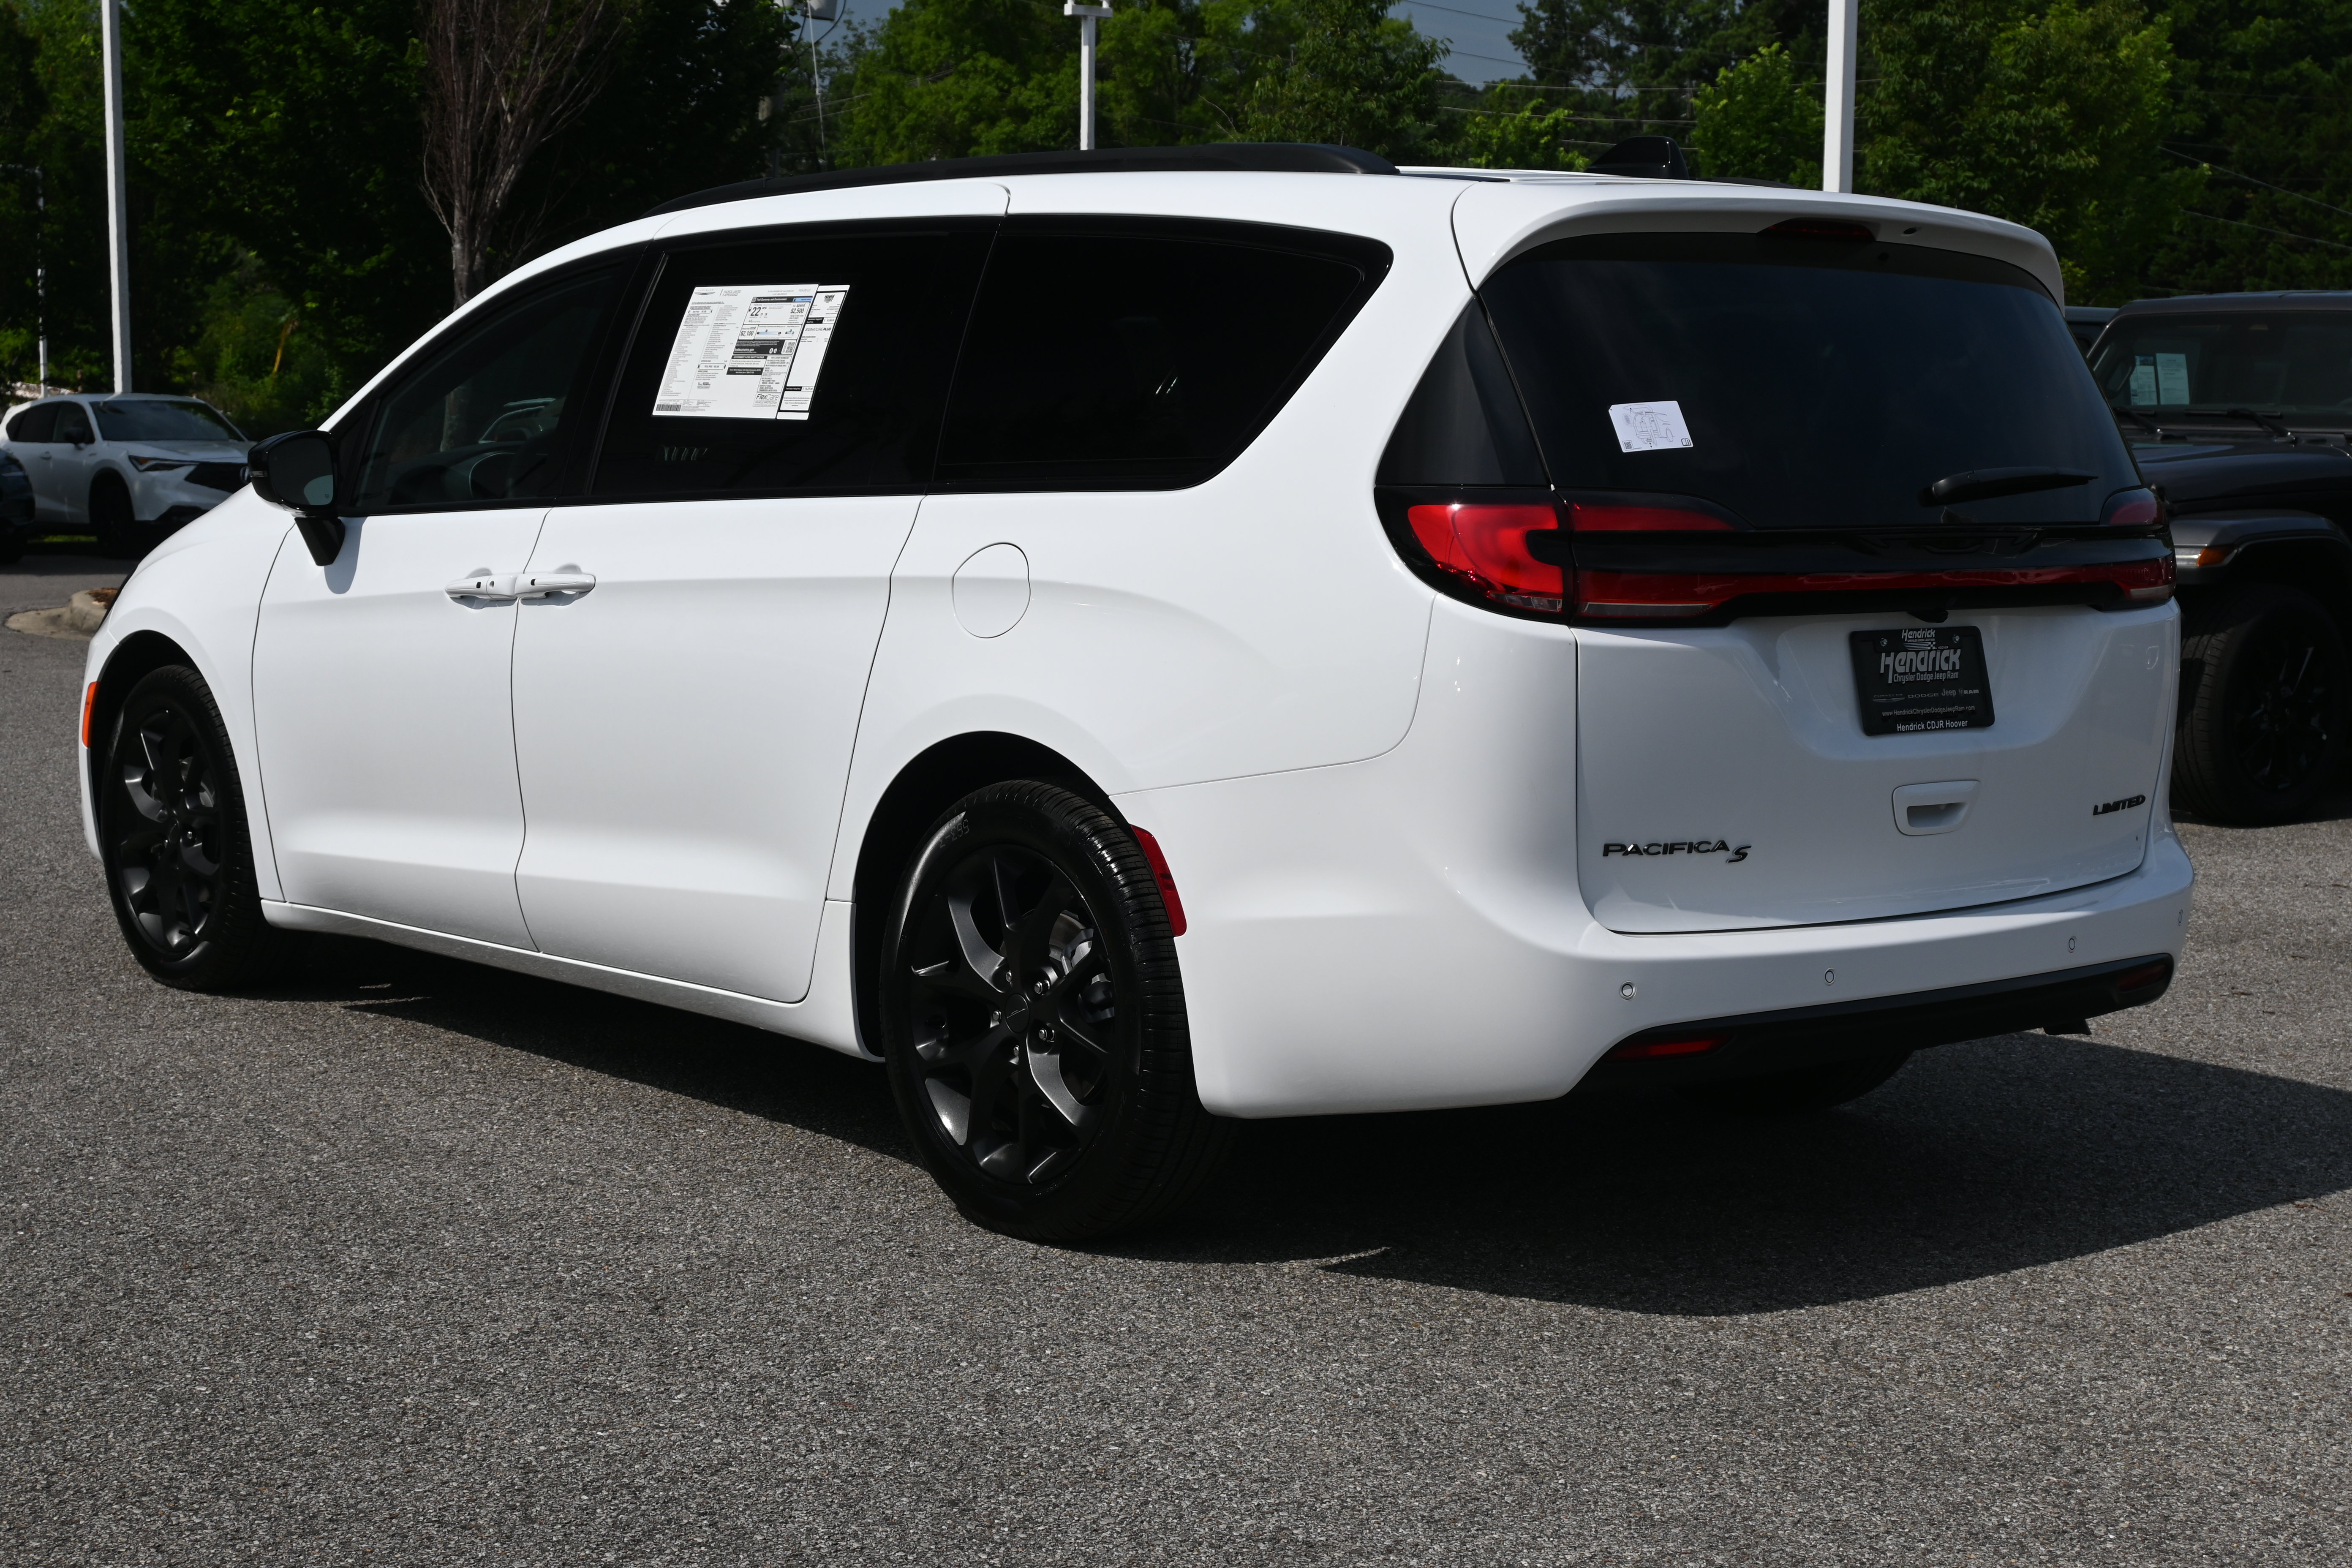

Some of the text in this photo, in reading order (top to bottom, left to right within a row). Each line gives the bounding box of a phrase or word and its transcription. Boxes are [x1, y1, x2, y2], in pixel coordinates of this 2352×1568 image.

[750, 307, 761, 316] 22
[1902, 629, 1936, 641] Hendrick
[1880, 649, 1961, 683] Hendrick
[1894, 674, 1915, 684] Chrysler
[1916, 672, 1933, 683] Dodge
[1934, 672, 1946, 681] Jeep
[1941, 689, 1957, 697] Jeep
[1897, 719, 1968, 732] Hendrick CDJR Hoover
[2093, 795, 2146, 815] LIMITED
[1603, 840, 1752, 863] PACIFICA S
